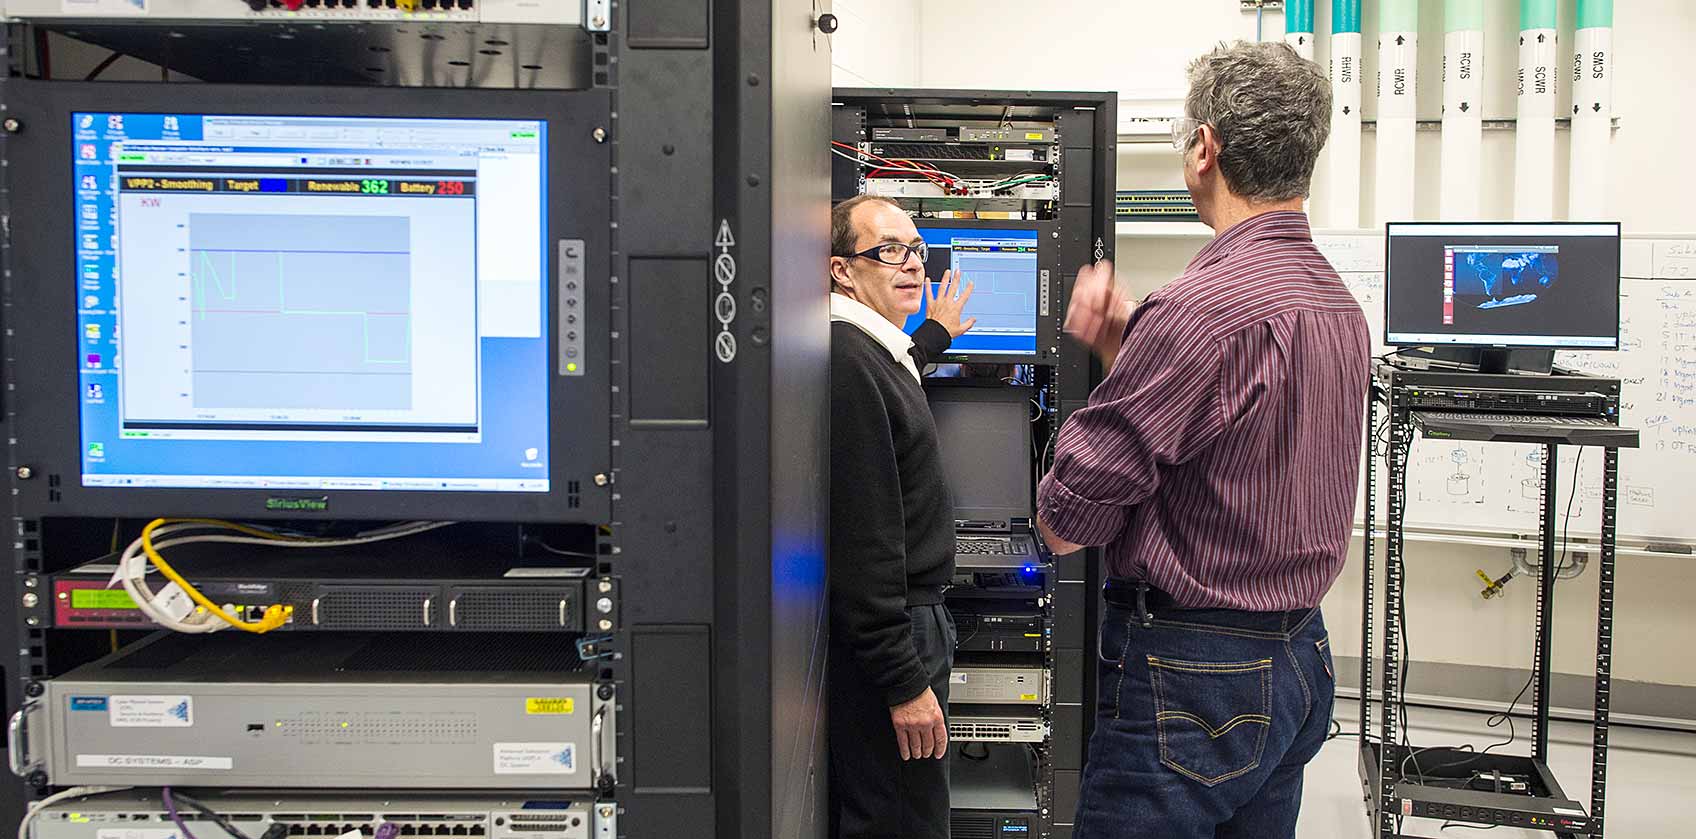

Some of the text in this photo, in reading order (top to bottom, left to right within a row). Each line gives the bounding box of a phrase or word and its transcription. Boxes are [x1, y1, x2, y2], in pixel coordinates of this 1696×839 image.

[1341, 56, 1351, 83] RHWS
[1460, 52, 1471, 79] RCWS
[1592, 51, 1604, 79] SCWS
[1394, 68, 1404, 95] RCWR
[1535, 66, 1546, 94] SCWR
[127, 179, 154, 189] VPP2
[161, 179, 214, 191] Smoothing
[227, 180, 259, 191] Target
[308, 180, 388, 194] Renewable 362
[400, 181, 464, 195] Battery 250
[266, 498, 327, 509] SiriusView
[125, 757, 172, 766] SYSTEMS
[183, 758, 203, 766] ASP
